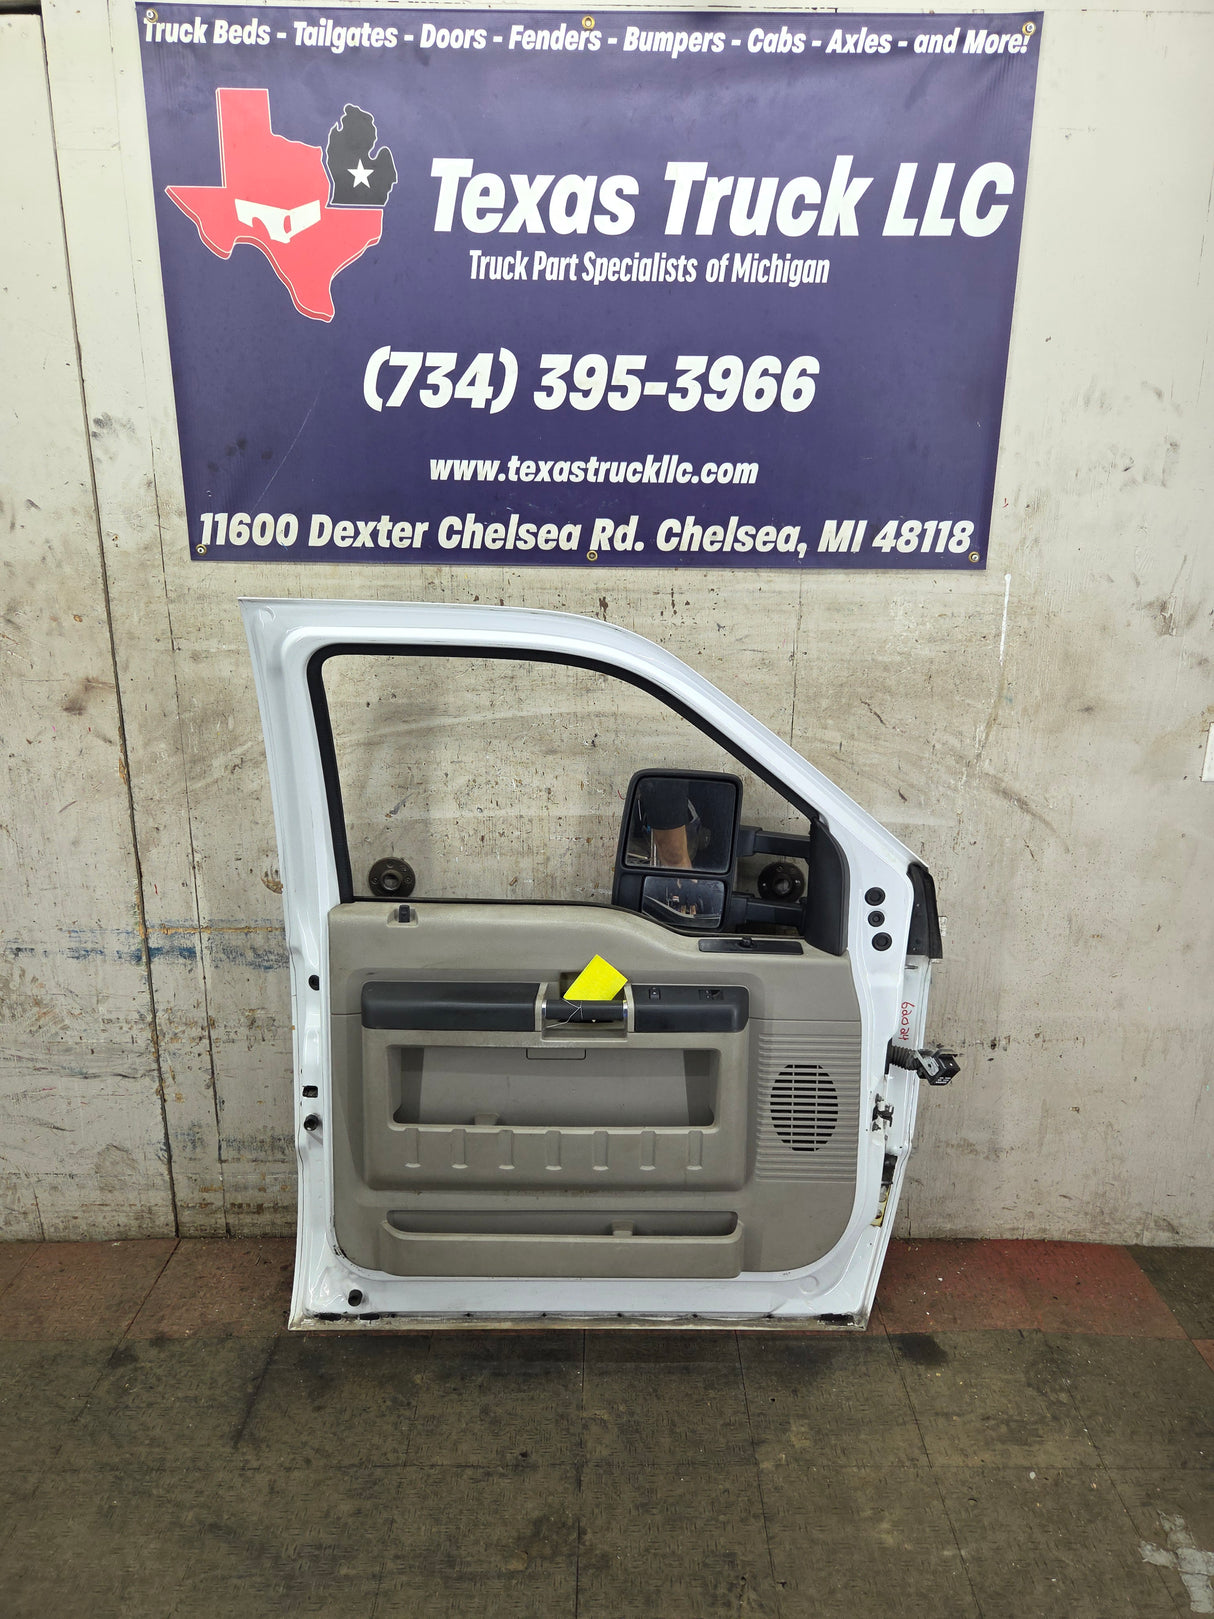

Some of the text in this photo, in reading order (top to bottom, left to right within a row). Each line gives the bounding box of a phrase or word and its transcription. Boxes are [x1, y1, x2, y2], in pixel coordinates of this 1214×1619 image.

[143, 17, 208, 43] Truck
[213, 18, 271, 45] Beds
[294, 18, 398, 54] Tailgates
[420, 23, 487, 49] Doors
[509, 23, 602, 51] Fenders
[623, 26, 726, 59] Bumpers
[748, 26, 806, 53] Cabs
[825, 27, 892, 54] Axles
[914, 27, 961, 54] and
[962, 29, 1031, 54] More!
[431, 155, 1014, 237] Texas Truck LLC
[470, 250, 830, 287] Truck Part Specialists of Michigan
[364, 346, 820, 414] (734) 395-3966
[430, 455, 758, 483] www.texastruckllc.com
[200, 513, 974, 558] 11600 Dexter Chelsea Rd. Chelsea, MI 48118
